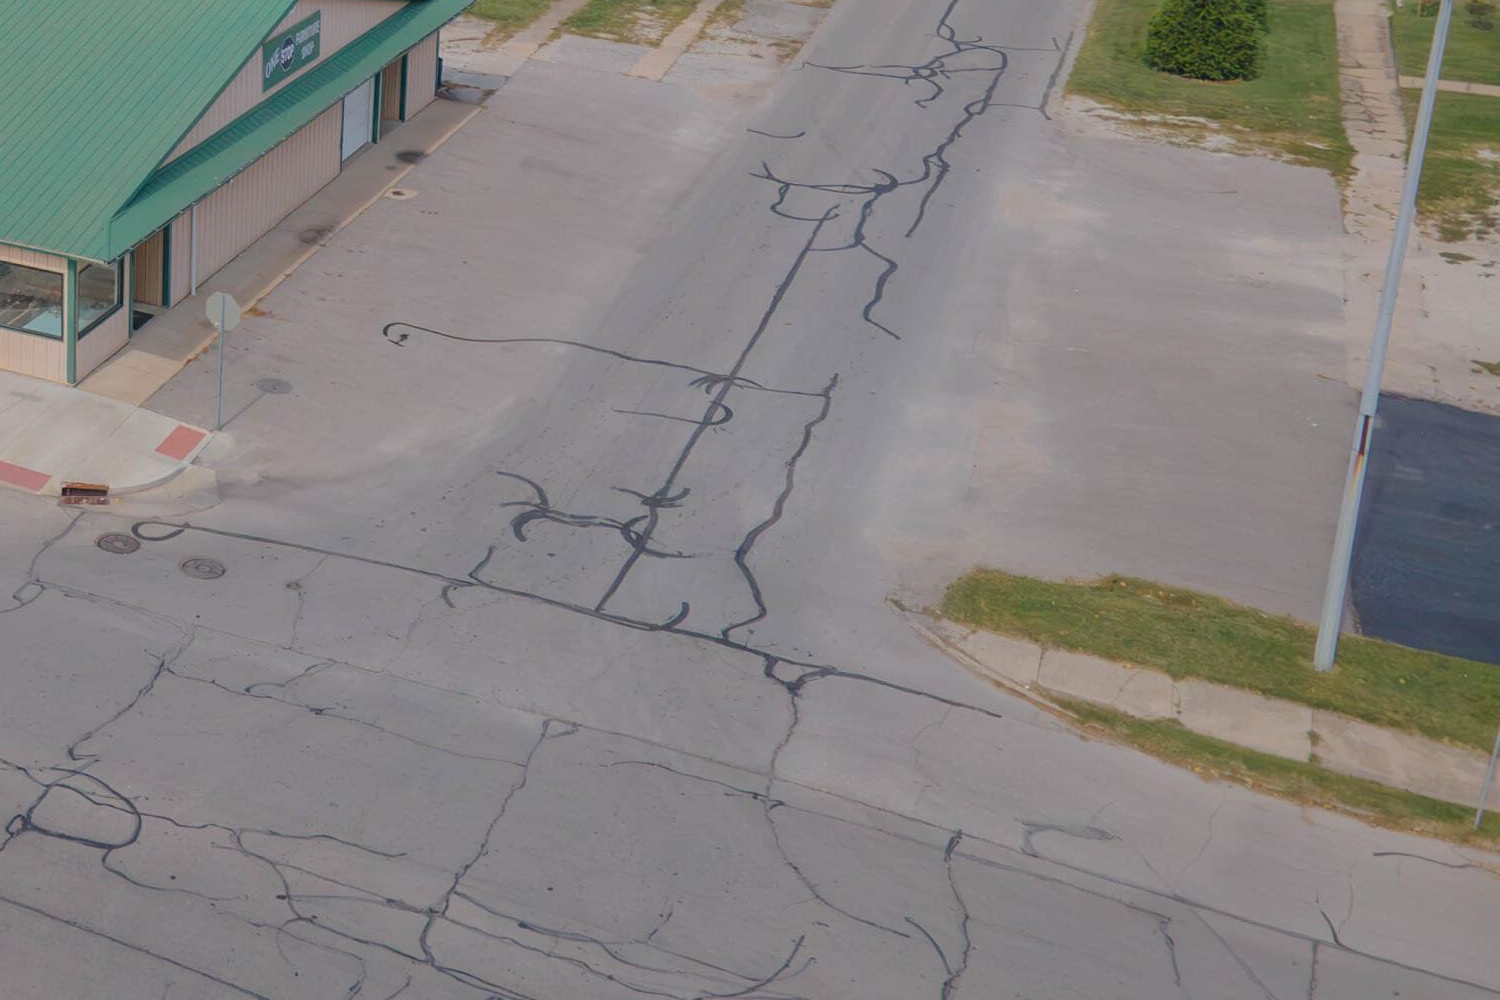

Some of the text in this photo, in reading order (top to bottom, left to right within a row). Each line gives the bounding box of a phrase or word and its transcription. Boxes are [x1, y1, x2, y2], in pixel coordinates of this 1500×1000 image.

[295, 20, 320, 46] FURNITURE
[280, 43, 295, 64] STOP
[301, 40, 315, 60] SHOP
[265, 47, 280, 79] ONE
